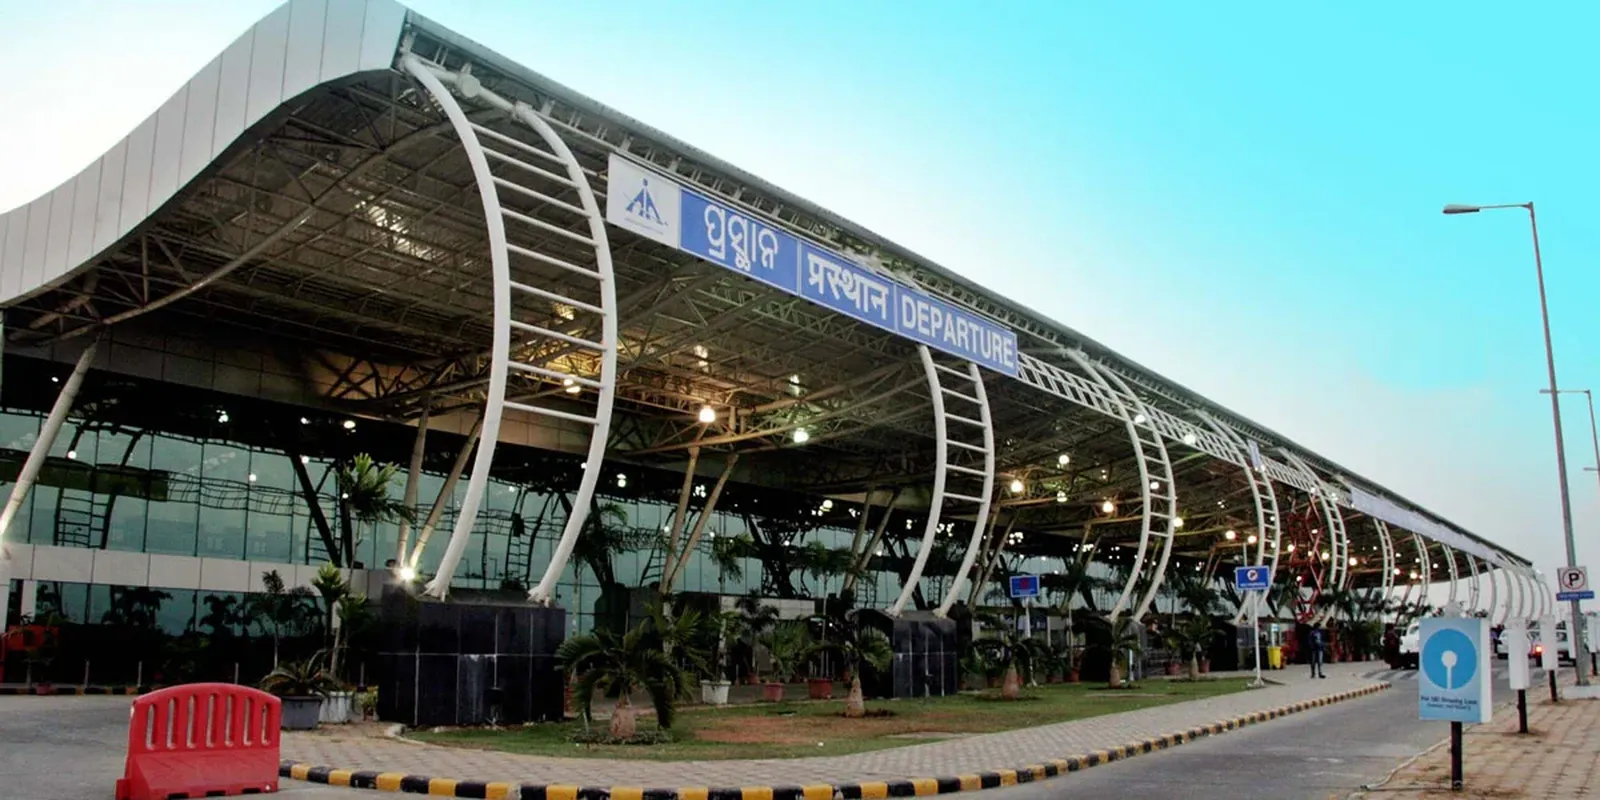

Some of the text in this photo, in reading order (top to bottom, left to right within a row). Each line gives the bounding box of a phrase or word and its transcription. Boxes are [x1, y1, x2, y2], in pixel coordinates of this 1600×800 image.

[704, 204, 778, 271] ପ୍ରସ୍ଥାନ
[807, 252, 889, 320] प्रस्थान
[901, 294, 1014, 368] DEPARTURE
[1569, 572, 1579, 586] P
